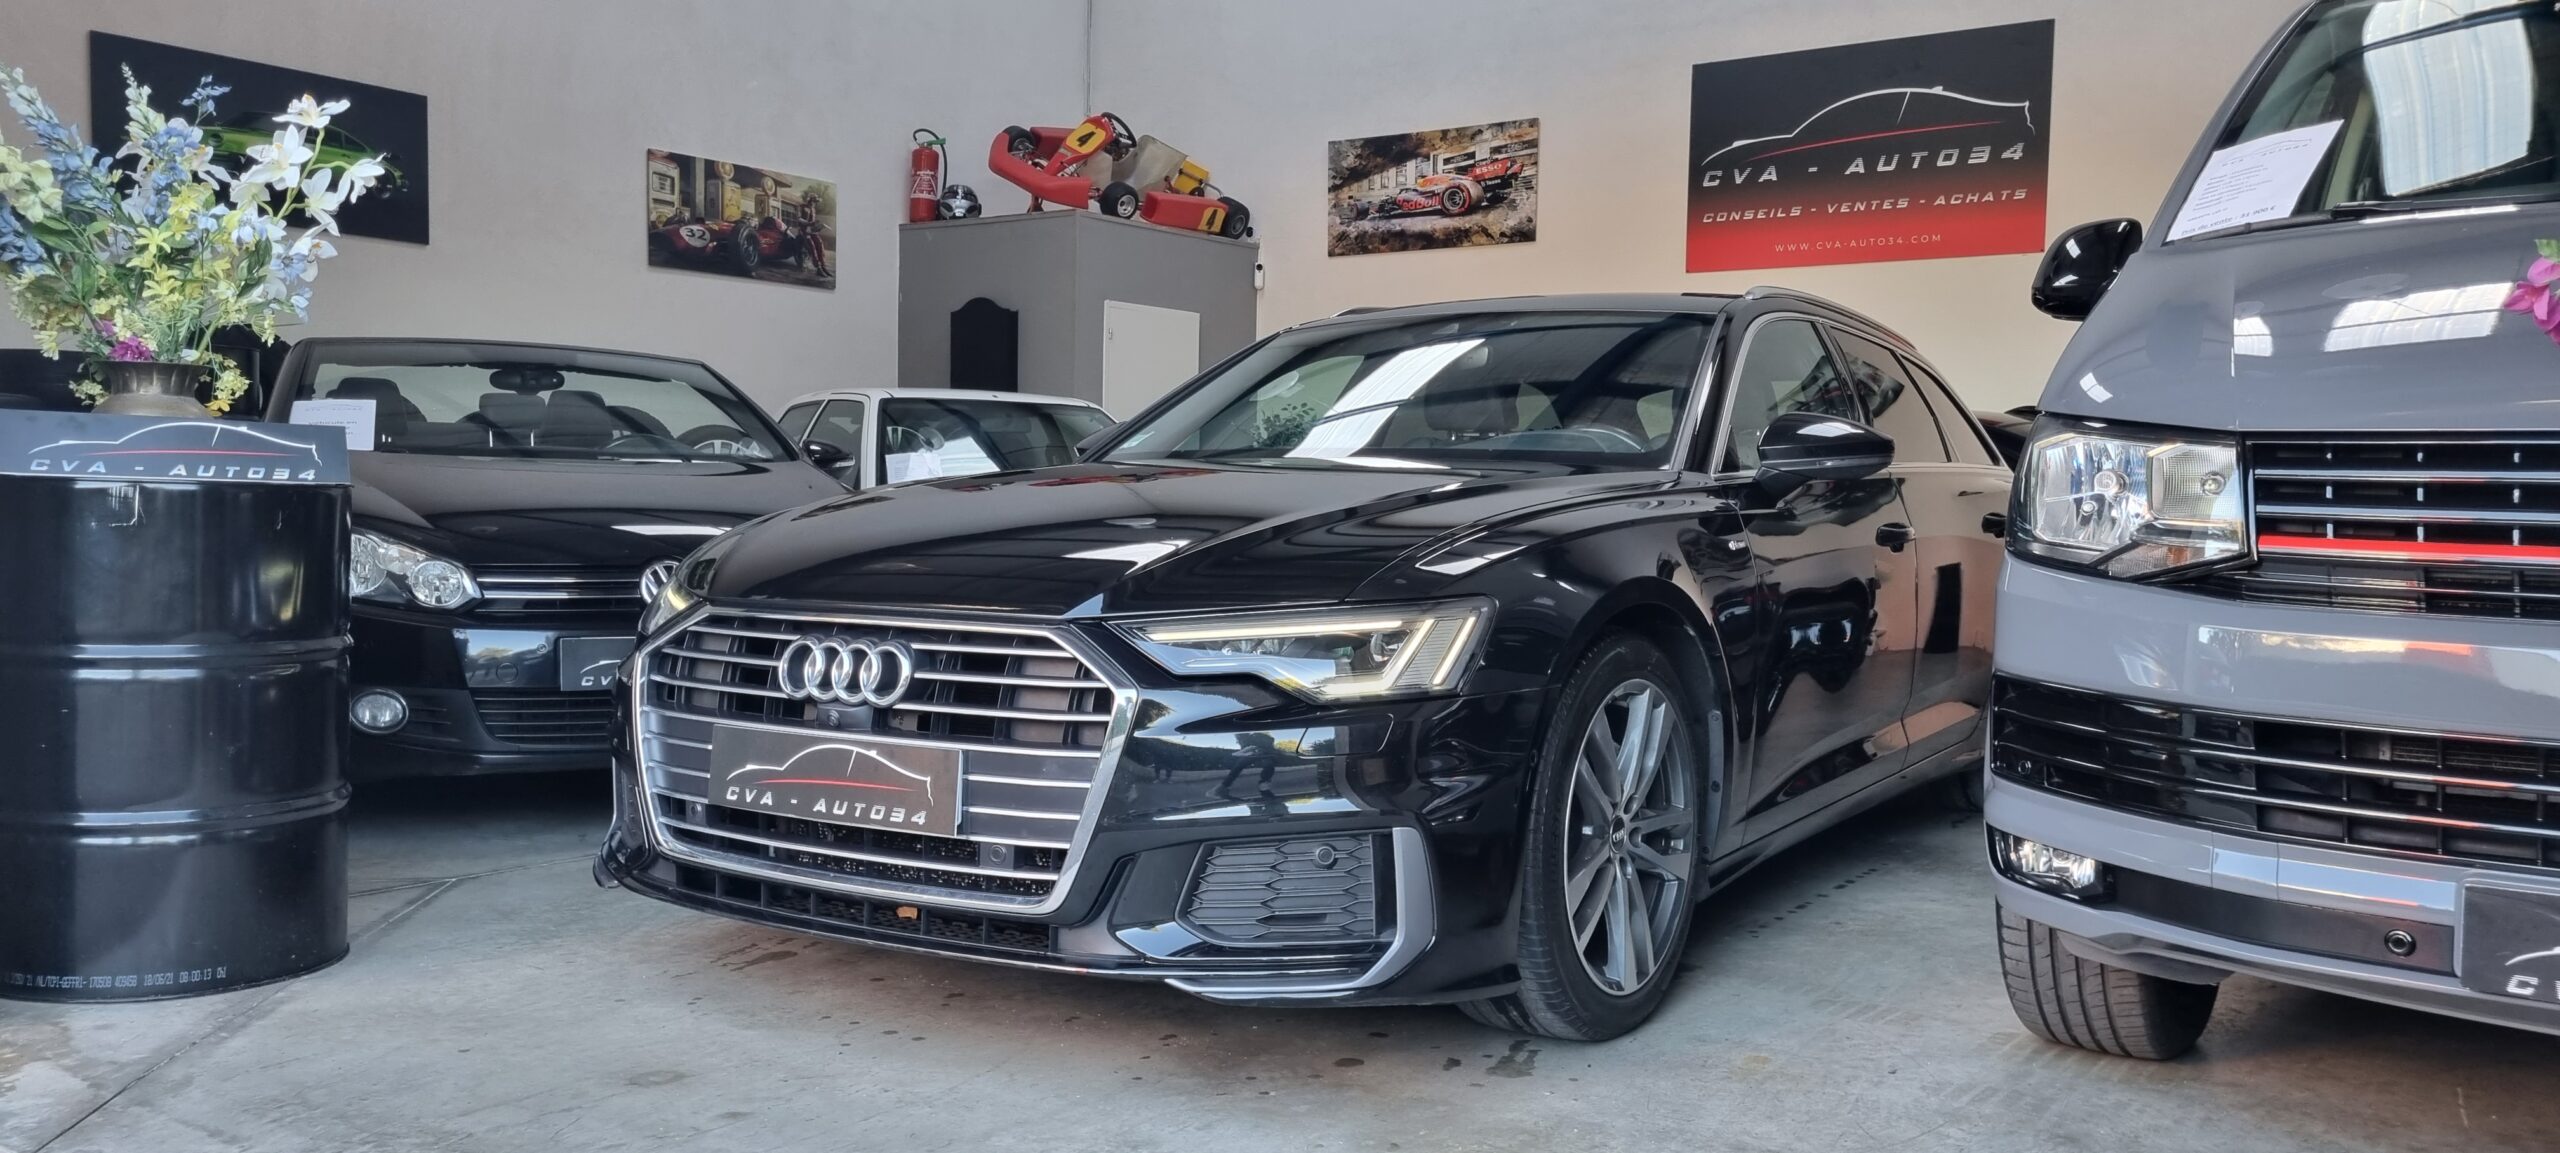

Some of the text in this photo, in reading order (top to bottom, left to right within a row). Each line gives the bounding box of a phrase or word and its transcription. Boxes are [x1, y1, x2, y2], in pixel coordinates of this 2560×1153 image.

[1076, 131, 1097, 148] 4
[1702, 165, 1778, 188] CVA
[1844, 142, 2025, 176] AUTO34
[1702, 205, 1802, 224] CONSEILS
[1827, 197, 1910, 214] VENTES
[1933, 188, 2028, 207] ACHATS
[1206, 209, 1219, 230] 4
[684, 226, 707, 242] 32
[1775, 234, 1942, 252] WWW.CVA-AUTO34.COM
[29, 458, 107, 474] CVA
[169, 464, 316, 481] AUTO34
[581, 676, 613, 686] CV
[726, 786, 773, 806] CVA
[812, 798, 927, 826] AUTO34
